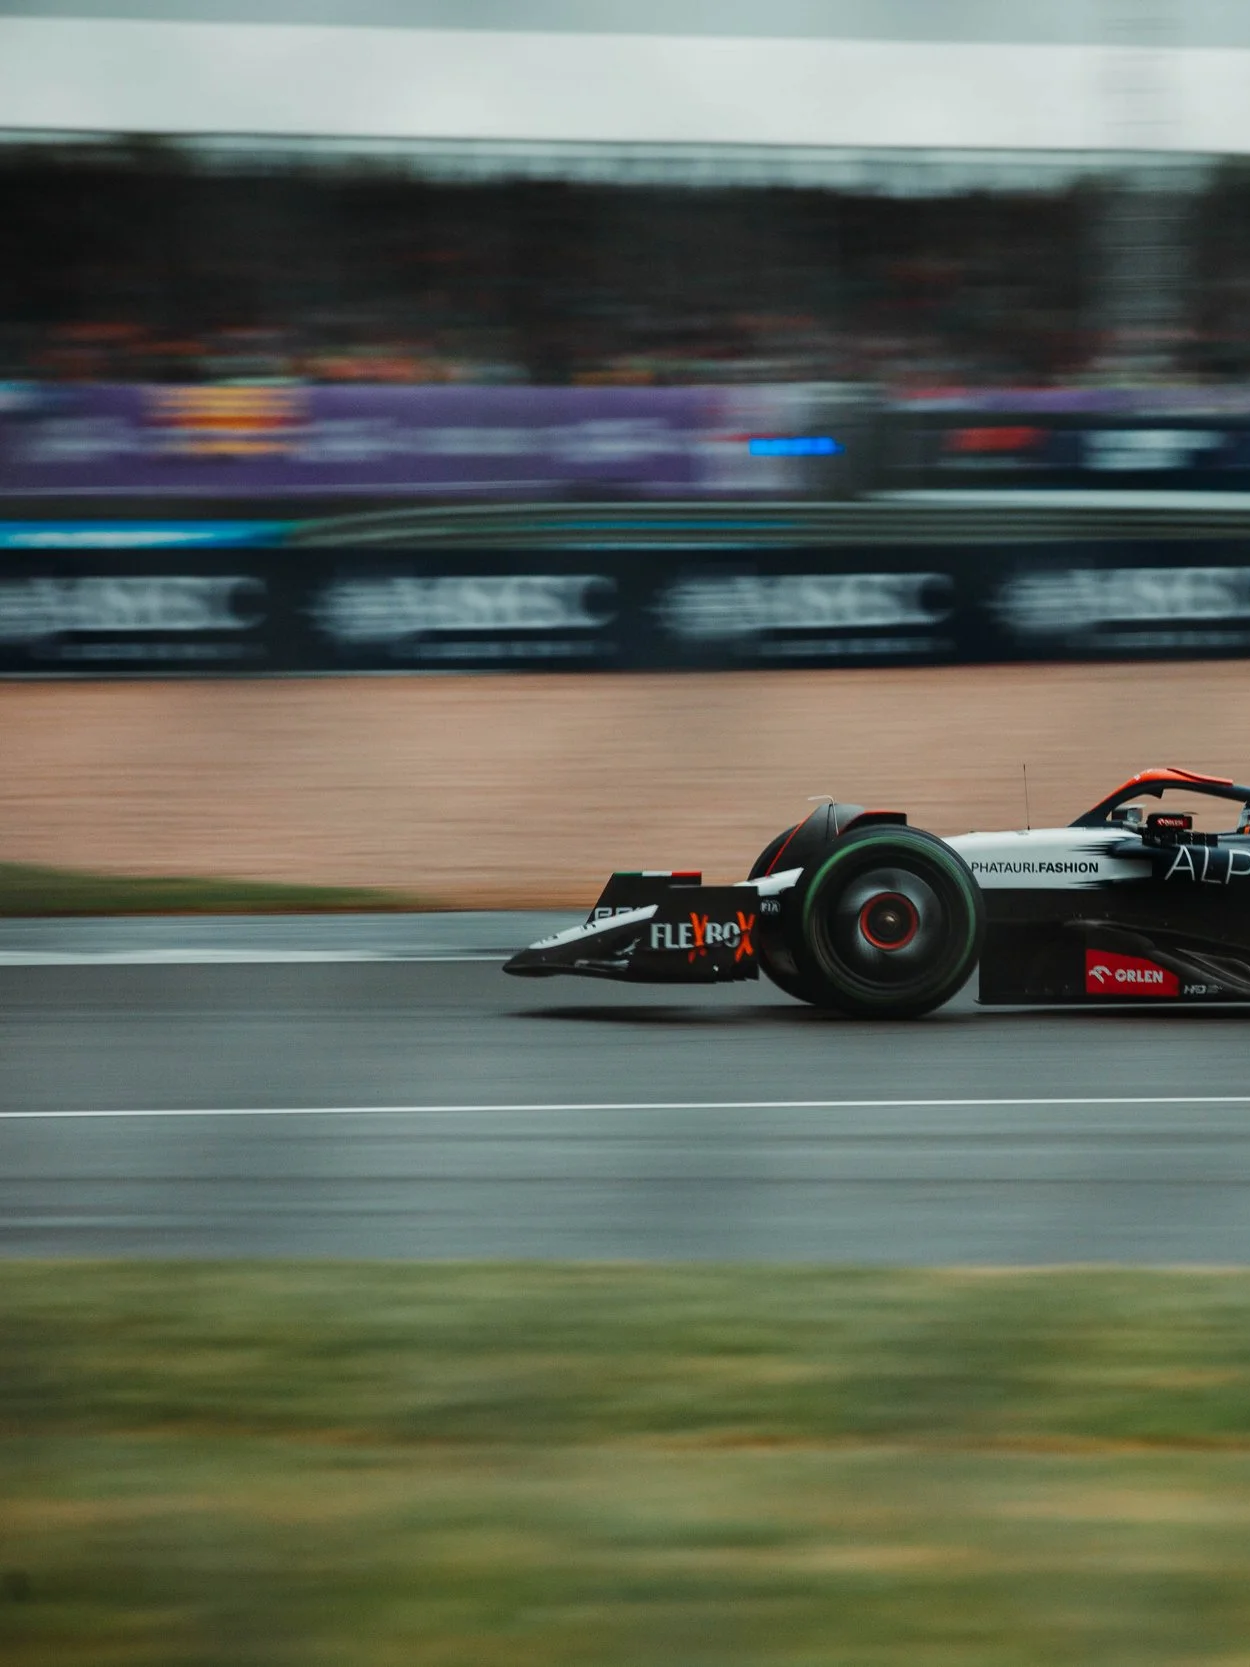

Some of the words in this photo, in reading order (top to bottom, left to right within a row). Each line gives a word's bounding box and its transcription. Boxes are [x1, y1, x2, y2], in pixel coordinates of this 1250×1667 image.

[971, 862, 1099, 873] PHATAURI.FASHION
[761, 901, 779, 913] FIA
[1115, 969, 1163, 983] ORLEN
